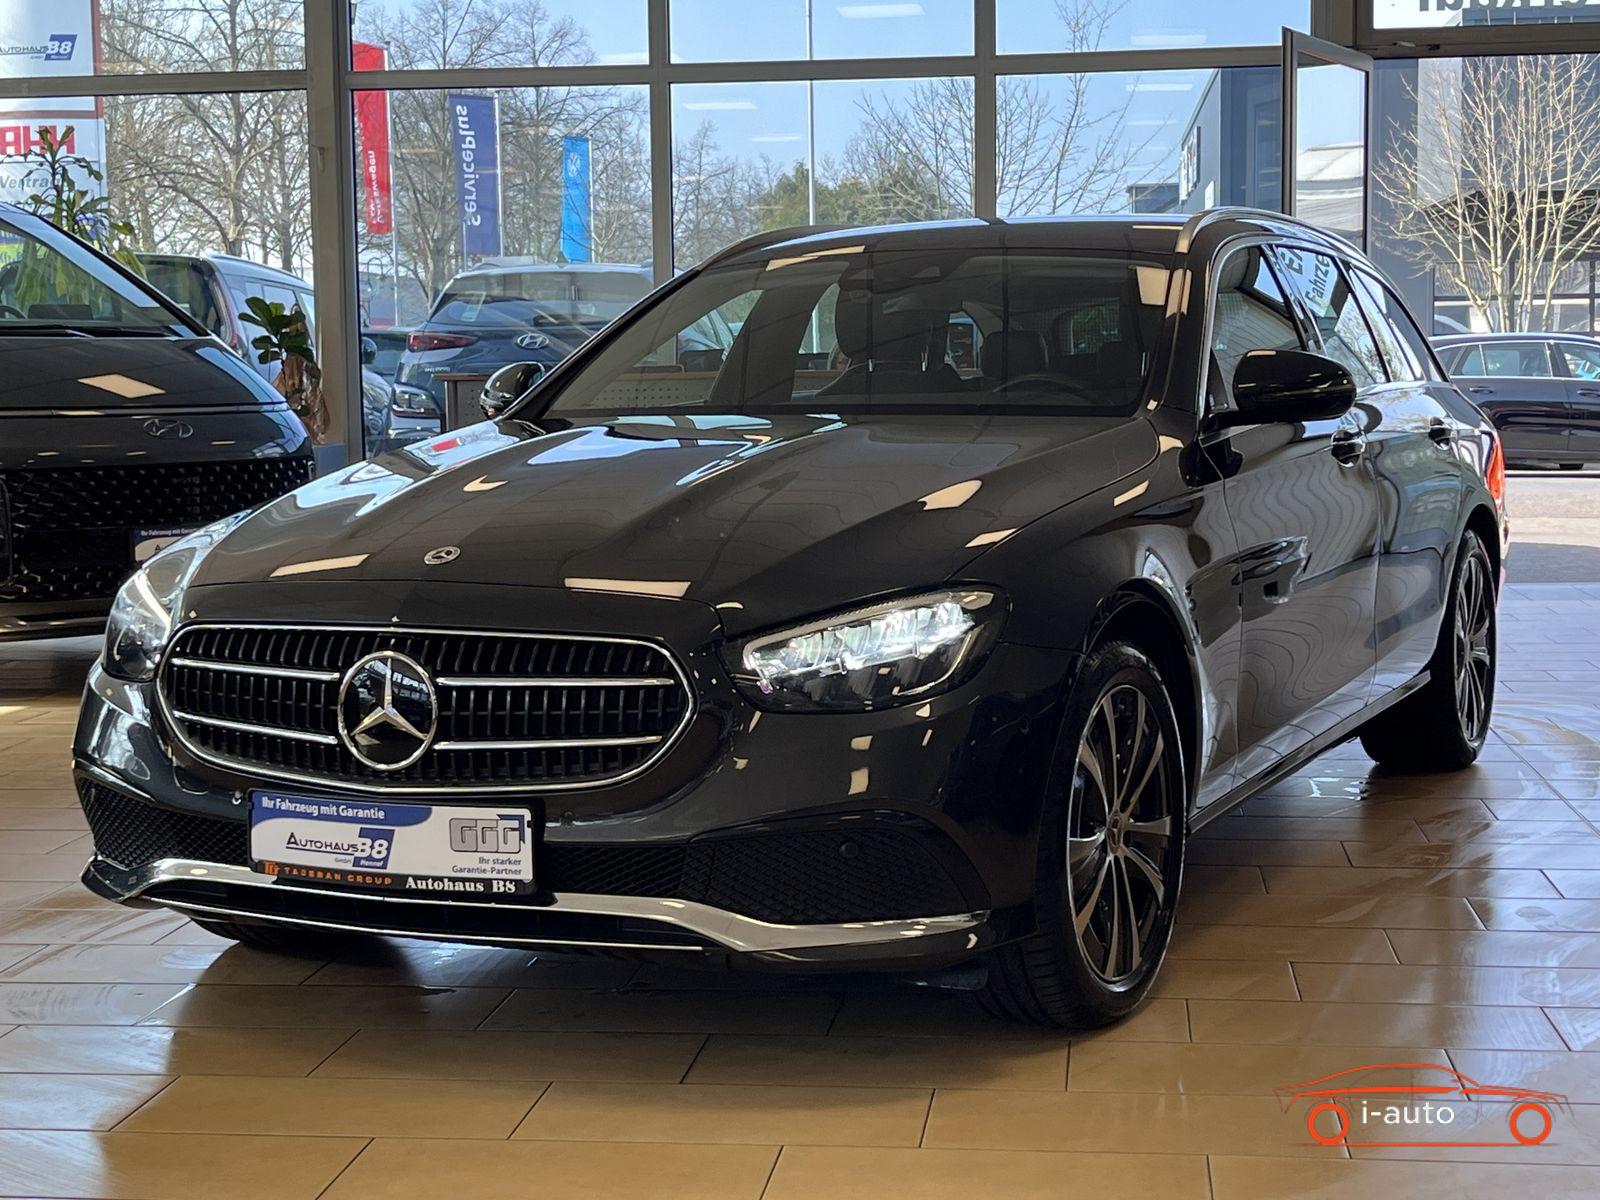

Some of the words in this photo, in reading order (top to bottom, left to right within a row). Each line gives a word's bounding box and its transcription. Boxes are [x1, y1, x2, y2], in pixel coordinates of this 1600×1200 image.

[262, 797, 275, 808] Ihr
[276, 799, 319, 815] Fahrzeug
[320, 804, 338, 815] mit
[339, 806, 385, 819] Garantie
[355, 838, 389, 859] B8
[479, 856, 490, 864] Ihr
[492, 858, 522, 866] starker
[452, 865, 522, 876] Garantie-Partner
[347, 874, 393, 886] GROUP
[405, 876, 485, 892] Autohaus
[492, 880, 516, 893] B8
